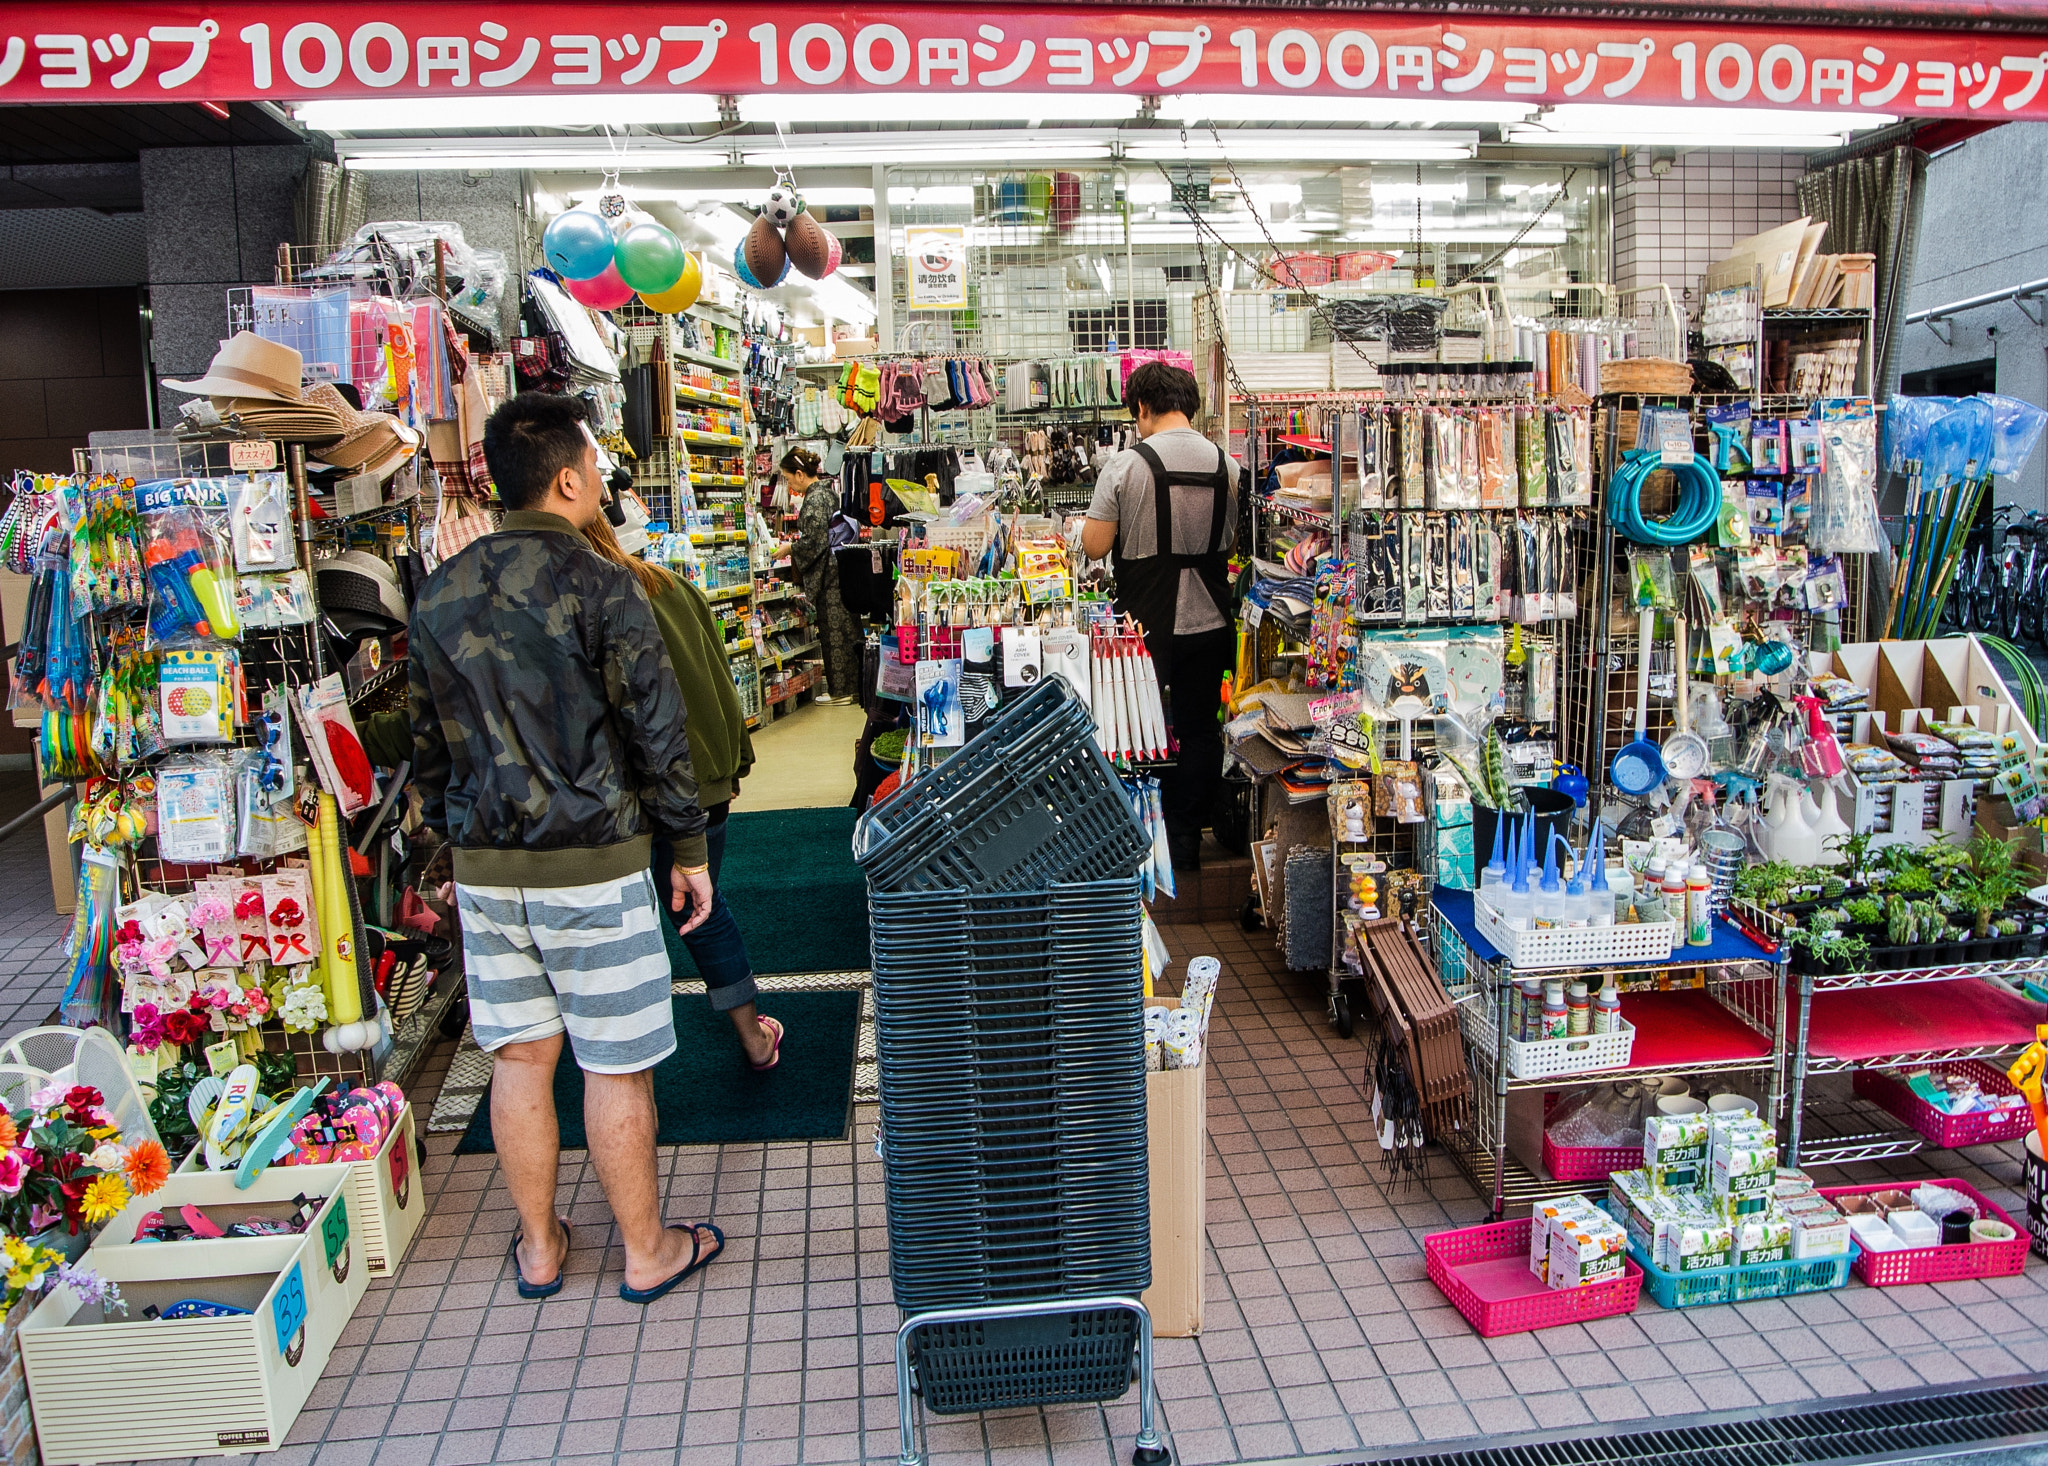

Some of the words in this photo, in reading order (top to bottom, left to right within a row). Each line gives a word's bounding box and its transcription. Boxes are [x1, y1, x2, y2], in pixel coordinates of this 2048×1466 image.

[241, 19, 728, 90] 100円ショップ
[748, 22, 1212, 88] 100円ショップ
[1229, 28, 1656, 100] 100円ショップ
[1672, 41, 2048, 112] 100円ショップ
[144, 490, 172, 507] BIG
[174, 484, 222, 502] TANK
[189, 666, 210, 674] BALL
[1663, 1148, 1700, 1162] 活力剤
[1734, 1173, 1771, 1190] 活力剤
[326, 1206, 347, 1260] SS
[1585, 1256, 1620, 1274] 活力剤
[1746, 1248, 1783, 1265] 活力剤
